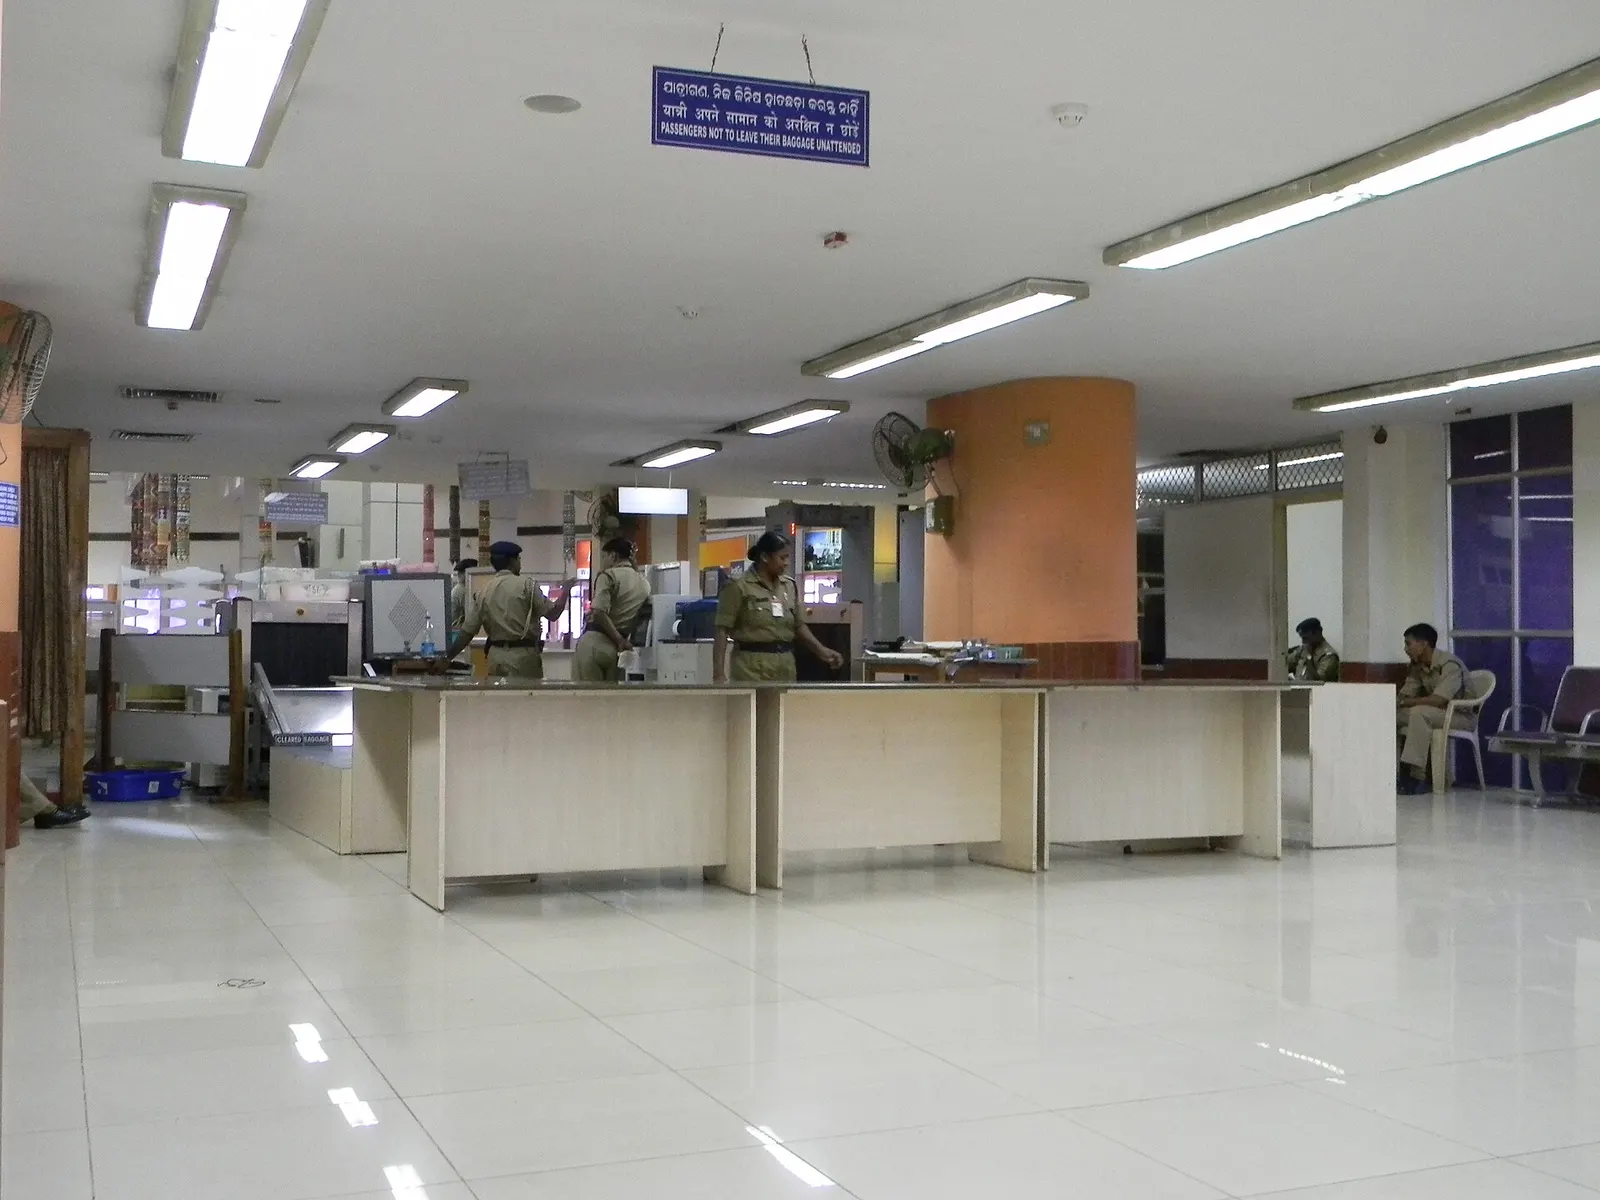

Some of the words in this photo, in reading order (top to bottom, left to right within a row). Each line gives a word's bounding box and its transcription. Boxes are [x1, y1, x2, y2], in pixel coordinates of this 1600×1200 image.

[662, 101, 688, 119] यात्री
[695, 104, 720, 122] अपने
[726, 111, 758, 127] सामान
[764, 111, 778, 129] को
[785, 115, 820, 134] अरक्षित
[826, 122, 834, 136] न
[661, 121, 707, 138] PASSENGERS
[709, 127, 724, 140] NOT
[725, 128, 735, 141] TO
[736, 129, 758, 143] LEAVE
[760, 132, 781, 146] THEIR
[782, 135, 815, 150] BAGGAGE
[816, 138, 861, 155] UNATTENDED
[276, 735, 302, 744] CLEARED
